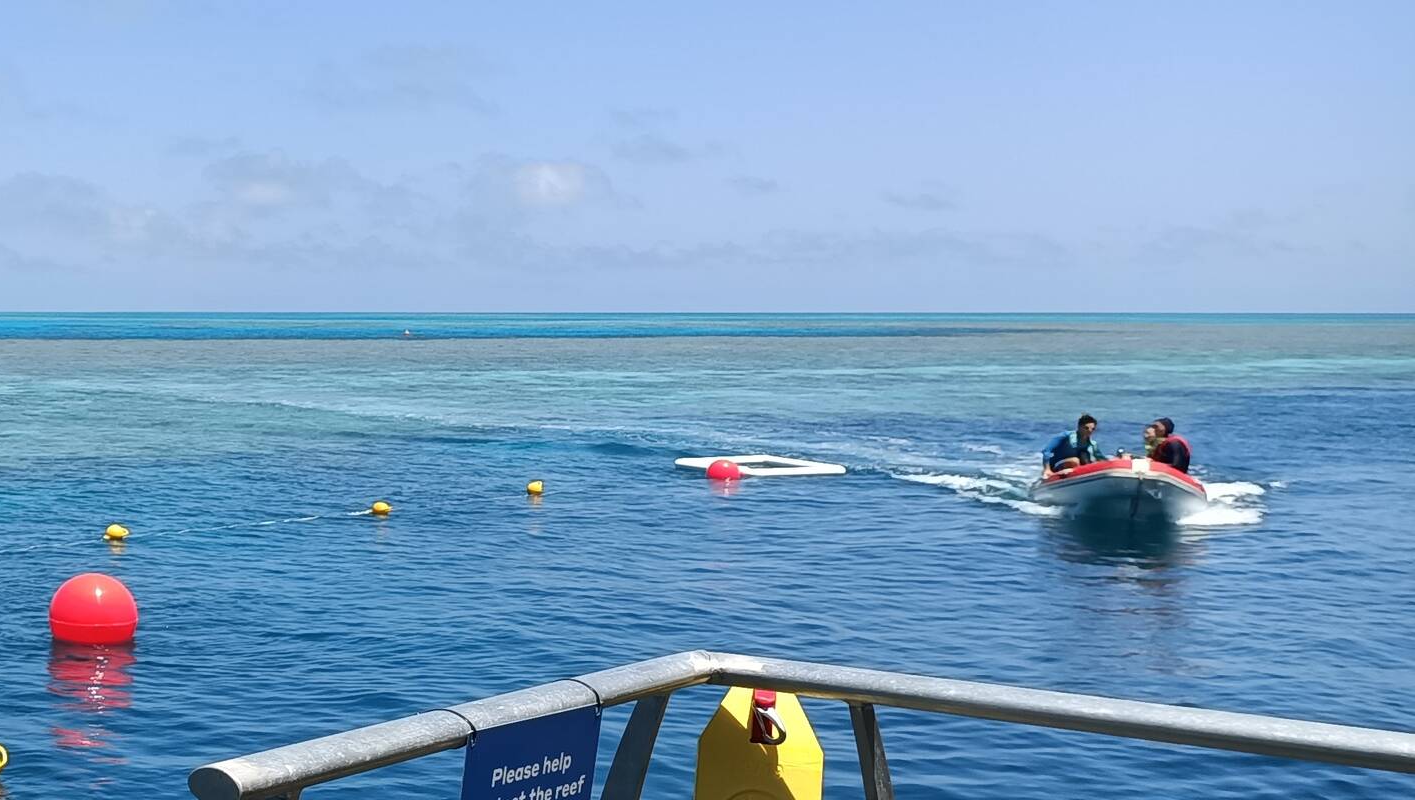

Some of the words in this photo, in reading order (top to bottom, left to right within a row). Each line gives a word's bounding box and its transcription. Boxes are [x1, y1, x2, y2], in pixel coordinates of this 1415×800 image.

[491, 763, 540, 788] Please
[542, 751, 572, 774] help
[529, 786, 553, 800] the
[555, 774, 586, 800] reef
